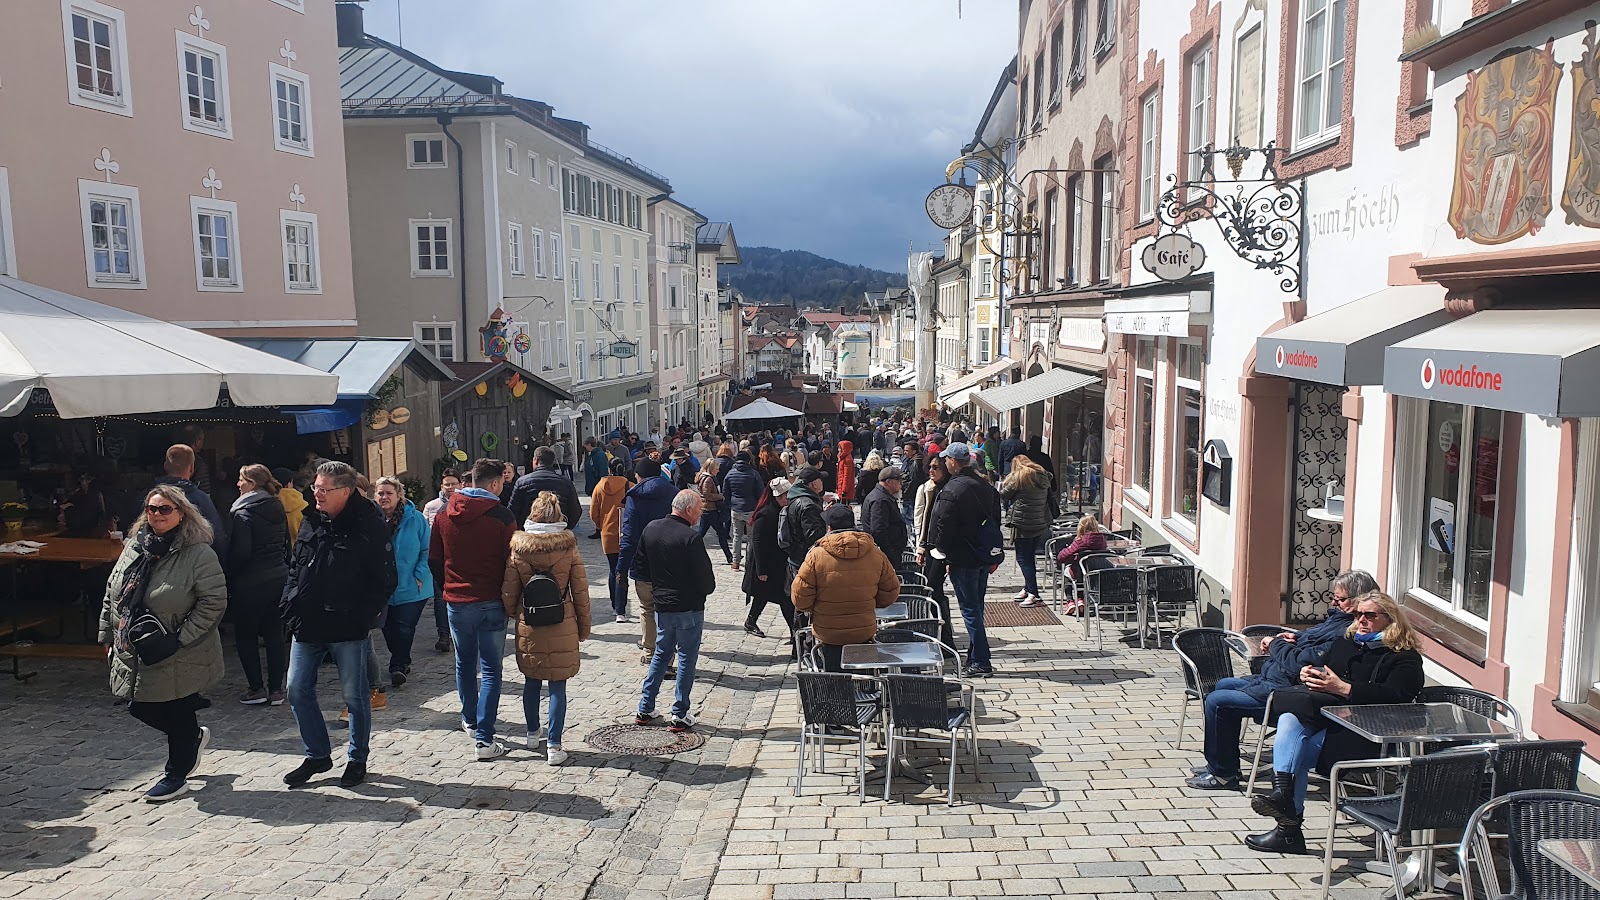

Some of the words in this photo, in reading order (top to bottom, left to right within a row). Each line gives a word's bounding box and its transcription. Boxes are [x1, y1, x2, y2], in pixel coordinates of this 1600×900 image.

[930, 208, 970, 227] TRACHTENSTUBE
[1157, 249, 1189, 268] Café
[613, 346, 633, 354] HOTEL
[1285, 349, 1318, 369] vodafone
[1439, 364, 1502, 391] vodafone
